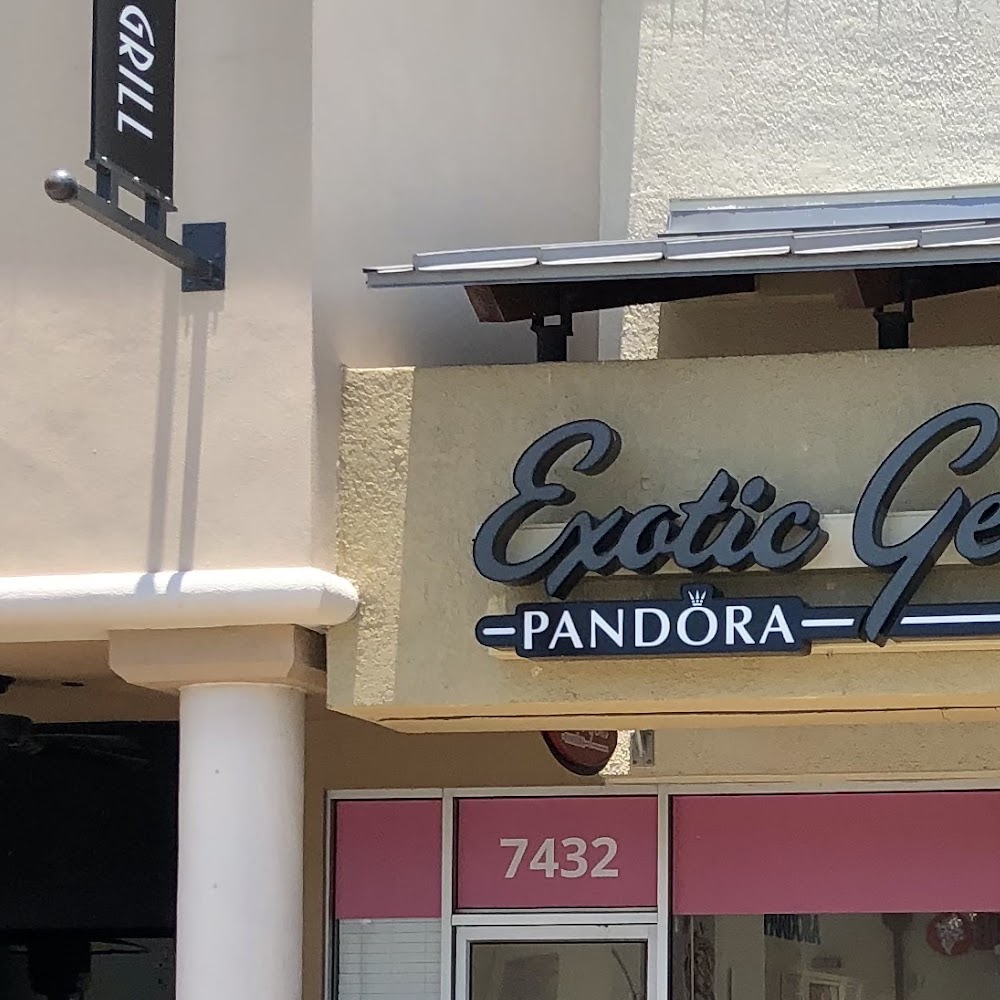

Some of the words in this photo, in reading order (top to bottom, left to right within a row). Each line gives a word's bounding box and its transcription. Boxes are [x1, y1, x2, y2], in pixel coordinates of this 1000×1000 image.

[117, 4, 155, 140] GRILL
[472, 418, 829, 599] Exotic
[521, 596, 796, 652] PANDORA
[499, 836, 620, 879] 7432
